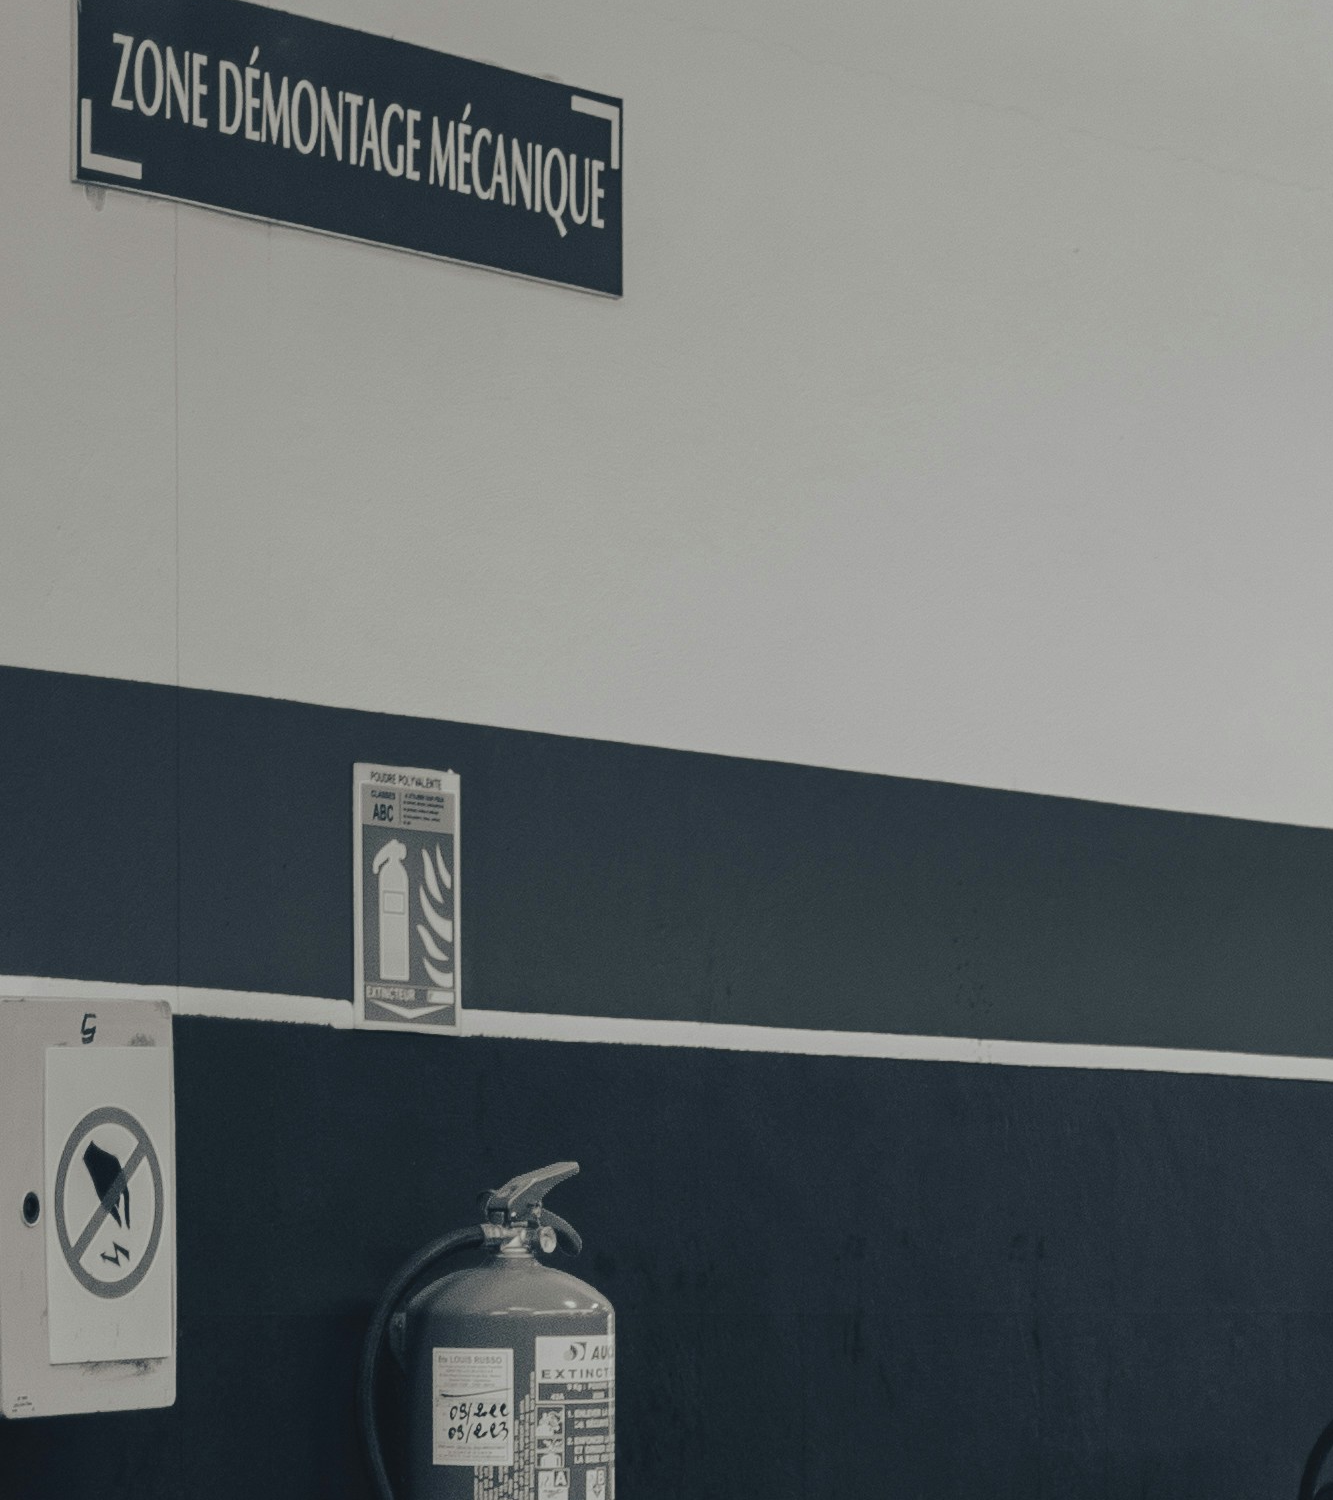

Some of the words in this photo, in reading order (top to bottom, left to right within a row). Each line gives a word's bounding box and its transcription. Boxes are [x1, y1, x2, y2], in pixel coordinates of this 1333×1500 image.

[111, 31, 208, 129] ZONE
[218, 46, 421, 182] DÉMONTAGE
[428, 102, 605, 238] MÉCANIQUE
[373, 803, 394, 823] ABC
